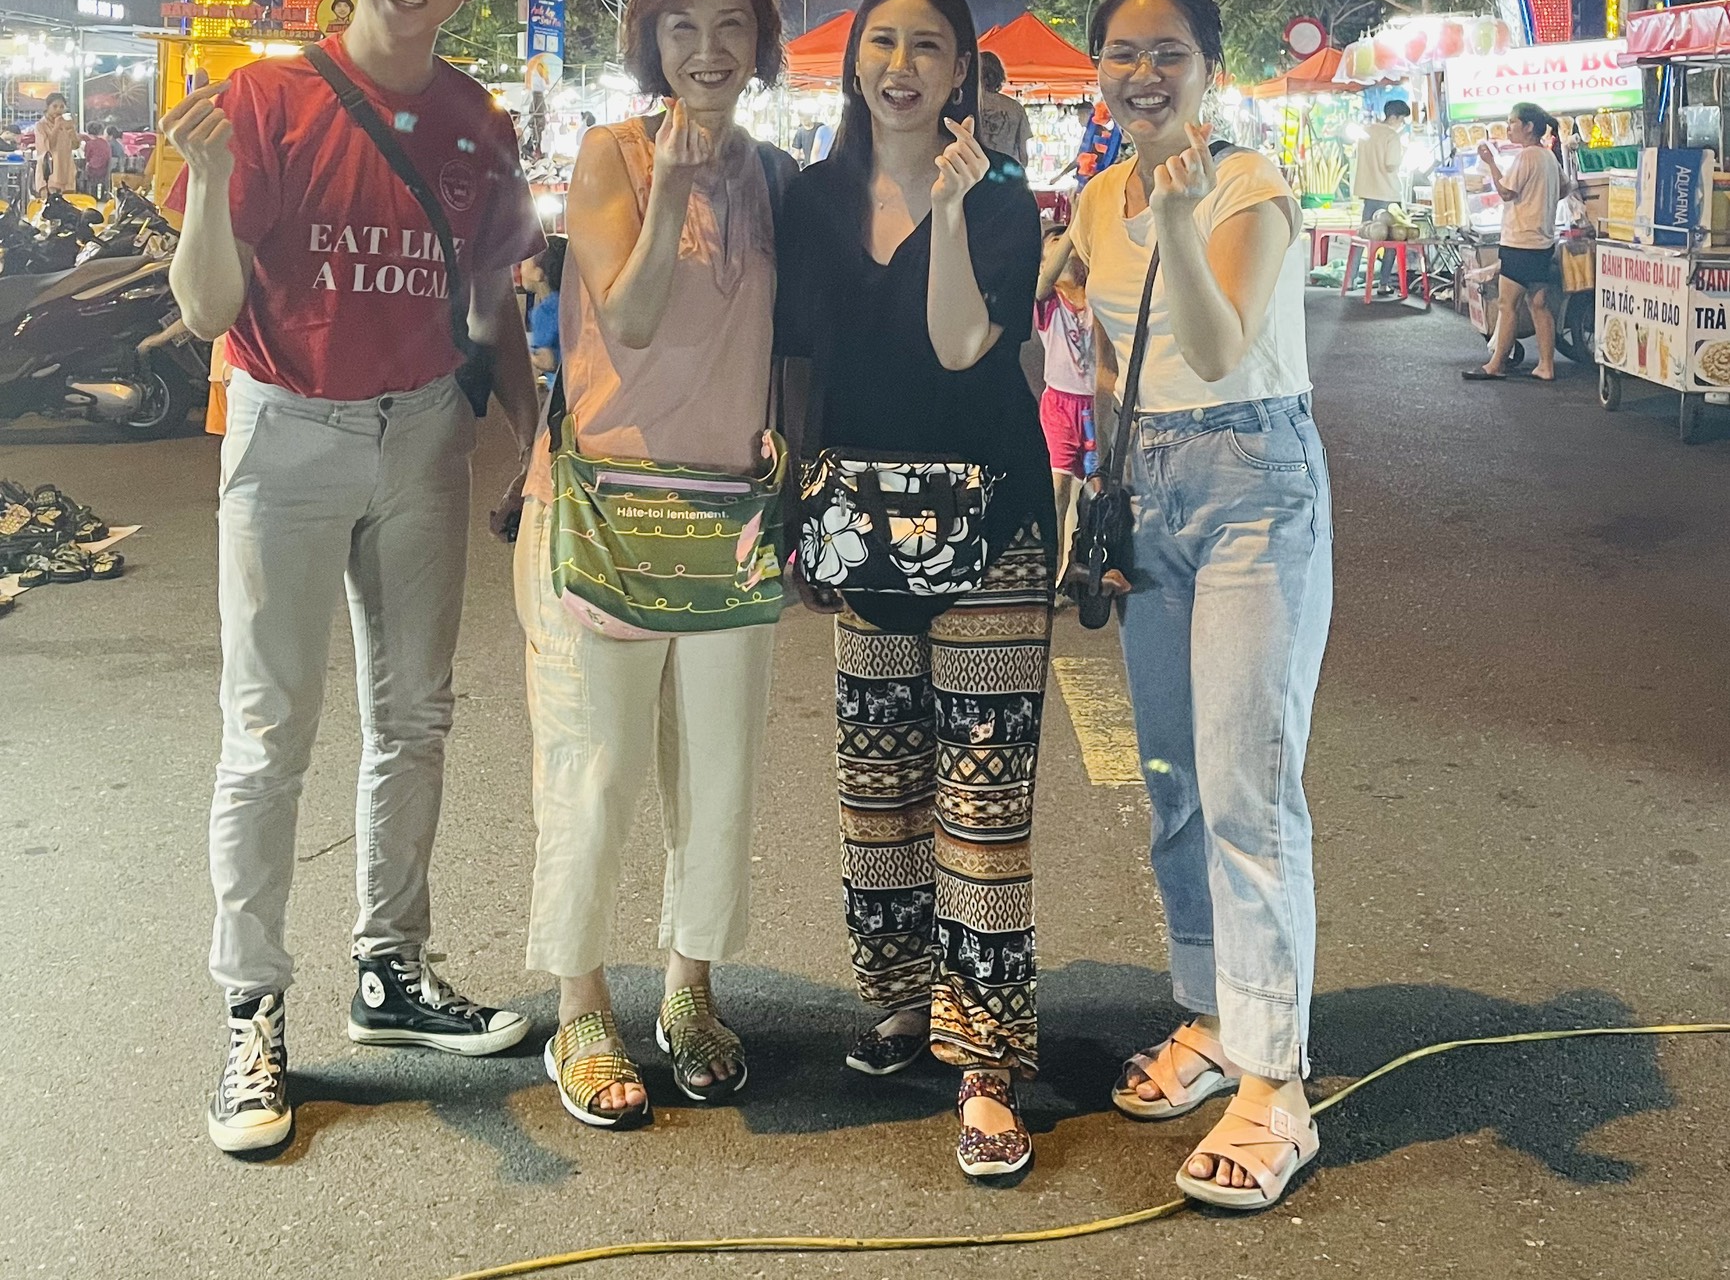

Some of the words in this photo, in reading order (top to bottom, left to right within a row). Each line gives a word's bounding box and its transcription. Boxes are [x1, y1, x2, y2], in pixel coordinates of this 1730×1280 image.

[1672, 164, 1692, 226] AQUAFINA
[308, 223, 389, 255] EAT
[312, 261, 338, 291] A
[352, 263, 450, 300] LOCAL
[1602, 251, 1623, 278] BÁNH
[1625, 255, 1651, 284] TRÁNG
[1601, 285, 1616, 311] TRÀ
[1618, 285, 1635, 315] TẮC
[1643, 296, 1659, 321] TRÀ
[1695, 303, 1727, 330] TRÀ
[616, 506, 664, 518] Hâte-toi
